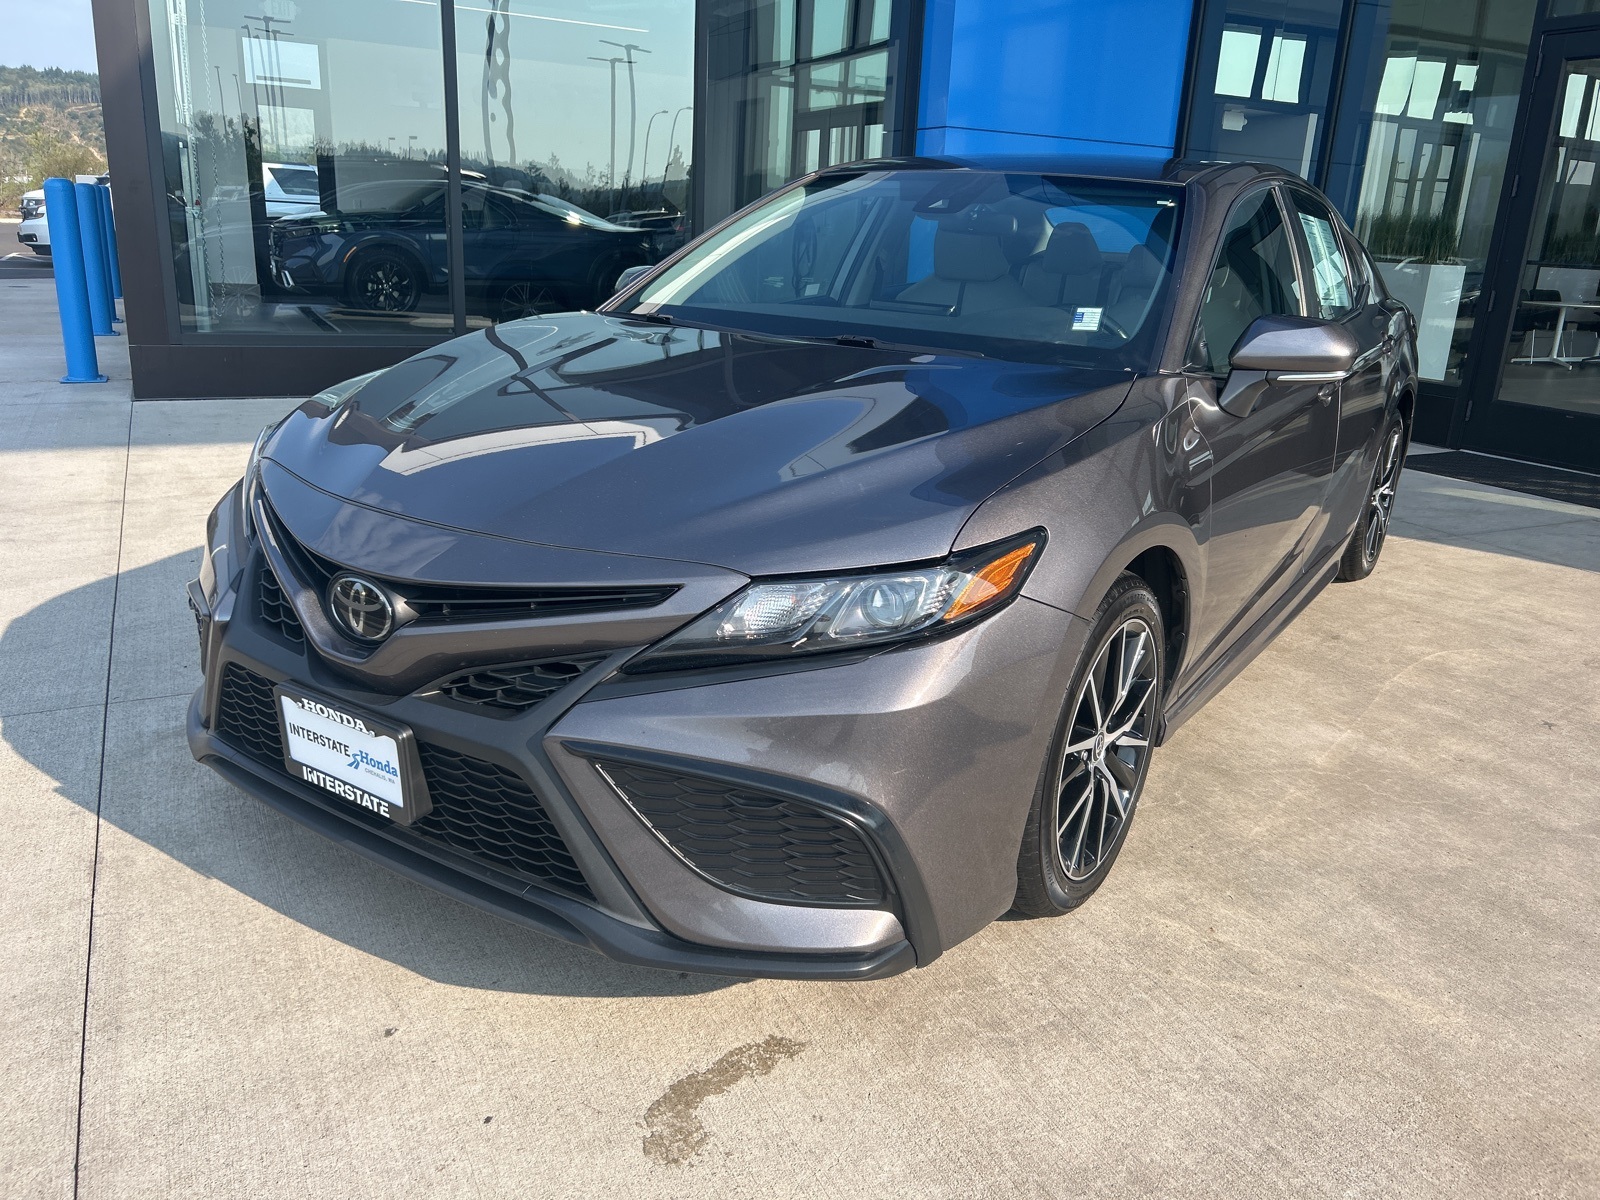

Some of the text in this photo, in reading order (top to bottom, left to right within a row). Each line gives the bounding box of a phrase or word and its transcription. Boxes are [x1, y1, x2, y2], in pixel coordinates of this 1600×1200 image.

[301, 698, 367, 734] HONDA
[289, 722, 398, 777] INTERSTATE Honda
[302, 766, 390, 818] INTERSTATE
